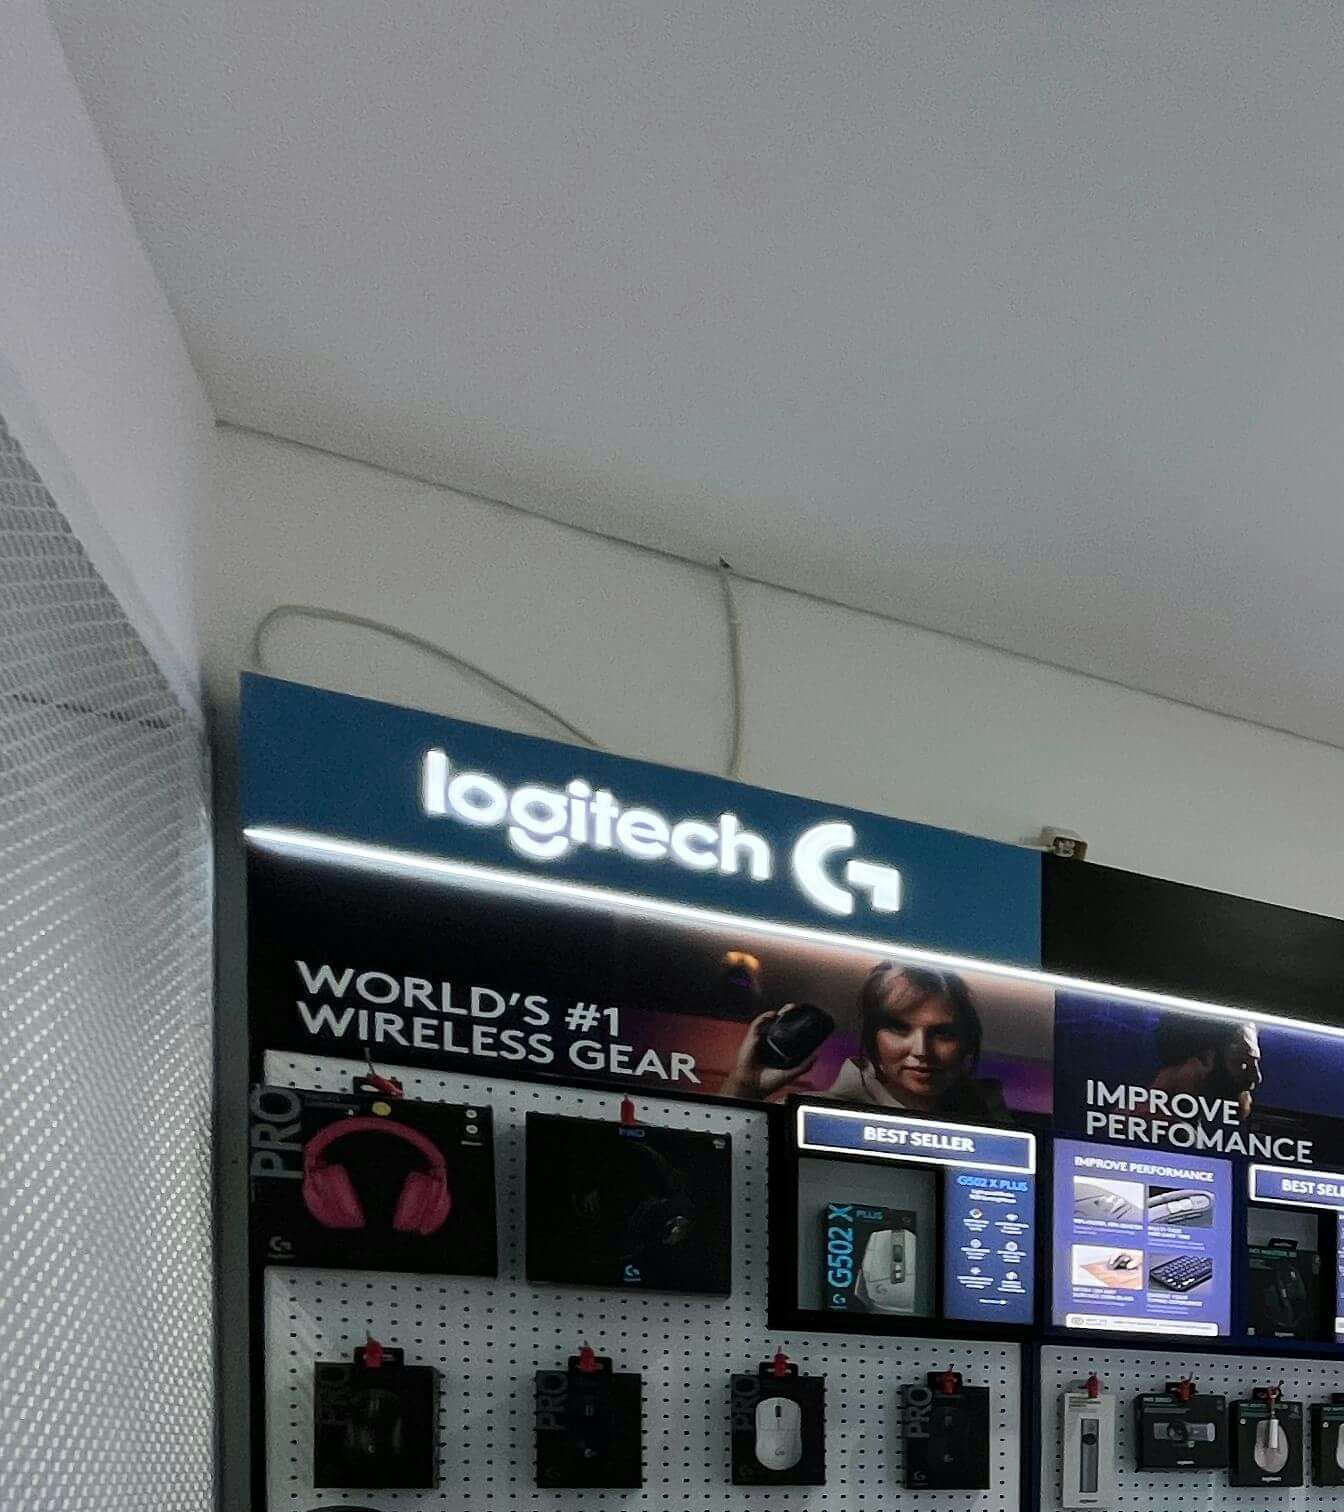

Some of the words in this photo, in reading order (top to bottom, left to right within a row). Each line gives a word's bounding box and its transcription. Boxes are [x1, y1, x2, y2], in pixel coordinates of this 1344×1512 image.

[421, 748, 771, 881] logitech
[295, 960, 550, 1026] WORLD'S
[565, 1002, 622, 1038] #1
[295, 1000, 556, 1066] WIRELESS
[567, 1035, 702, 1085] GEAR
[1085, 1079, 1242, 1127] IMPROVE
[251, 1089, 304, 1179] PRO
[863, 1126, 909, 1146] BEST
[909, 1130, 976, 1153] SELLER
[1085, 1111, 1314, 1165] PERFOMANCE
[1073, 1155, 1129, 1172] IMPROVE
[1129, 1163, 1215, 1183] PERFORMANCE
[1281, 1178, 1316, 1195] BEST
[827, 1227, 854, 1289] G502
